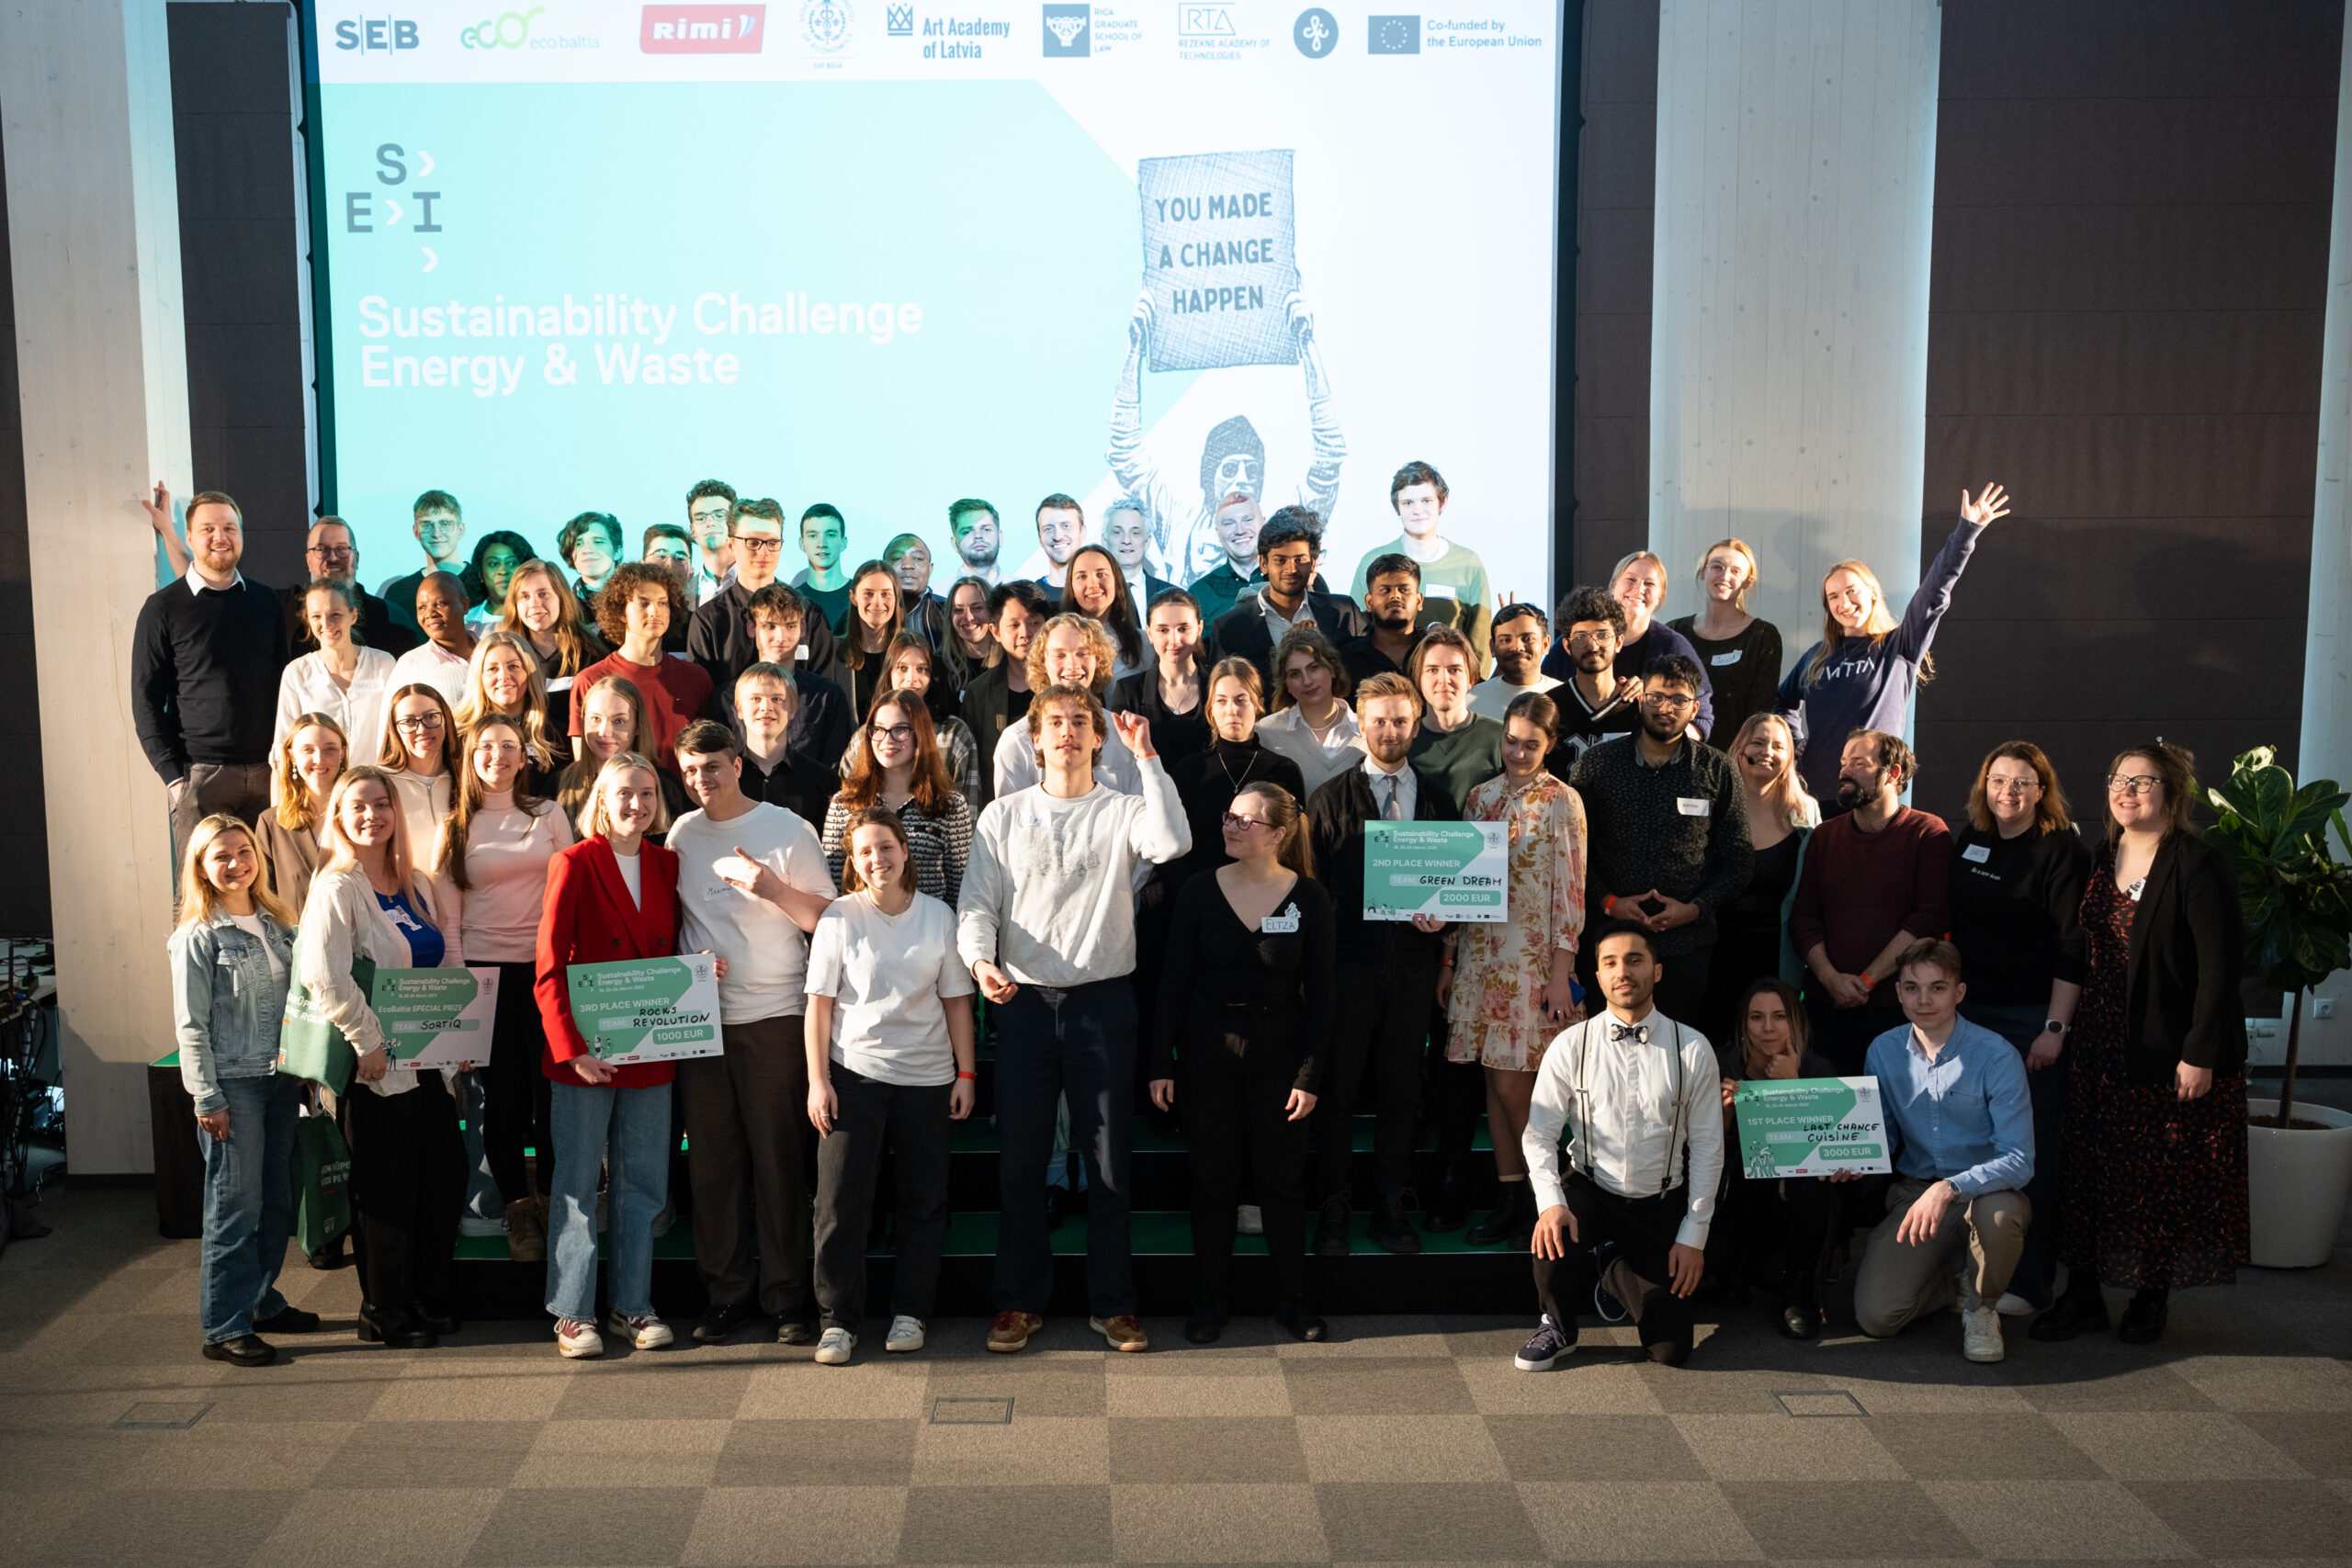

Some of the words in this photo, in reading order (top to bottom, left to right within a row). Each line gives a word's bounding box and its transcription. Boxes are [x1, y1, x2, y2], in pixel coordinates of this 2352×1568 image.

[922, 17, 944, 36] Art
[947, 17, 1011, 39] Academy
[1094, 20, 1139, 28] GRADUATE
[1427, 19, 1487, 30] Co-funded
[1491, 19, 1505, 33] by
[335, 20, 420, 50] SEB
[1094, 32, 1129, 40] SCHOOL
[1131, 32, 1142, 40] OF
[529, 37, 558, 50] eco
[560, 34, 600, 50] baltia
[1218, 39, 1257, 48] ACADEMY
[1260, 39, 1270, 48] OF
[1427, 36, 1445, 47] the
[1449, 36, 1505, 50] European
[1508, 36, 1543, 47] Union
[923, 40, 936, 59] of
[941, 40, 982, 59] Latvia
[1094, 45, 1112, 53] LAW
[1179, 51, 1241, 60] TECHNOLOGIES
[1155, 197, 1201, 222] YOU
[1208, 192, 1272, 220] MADE
[1159, 244, 1173, 269] A
[1181, 238, 1274, 267] CHANGE
[1173, 285, 1263, 314] HAPPEN
[358, 293, 676, 345] Sustainability
[693, 291, 923, 345] Challenge
[362, 344, 525, 399] Energy
[543, 343, 577, 386] &
[594, 342, 741, 385] Waste
[1393, 830, 1439, 839] Sustainability
[1441, 830, 1475, 839] Challenge
[1373, 859, 1391, 867] 2ND
[1393, 859, 1423, 867] PLACE
[1425, 860, 1461, 868] WINNER
[1419, 875, 1456, 886] GREEN
[1463, 875, 1502, 886] DREAM
[1443, 894, 1469, 902] 2000
[1471, 894, 1491, 902] EUR
[597, 970, 645, 979] Sustainability
[646, 966, 682, 976] Challenge
[399, 977, 440, 986] Sustainability
[441, 977, 470, 986] Challenge
[597, 977, 623, 987] Energy
[399, 985, 421, 993] Energy
[379, 1005, 411, 1013] EcoBaltia
[580, 1004, 598, 1012] 3RD
[600, 1000, 630, 1010] PLACE
[632, 997, 670, 1008] WINNER
[639, 1006, 677, 1017] ROCKS
[633, 1012, 710, 1028] REVOLUTION
[656, 1031, 683, 1041] 1000
[684, 1029, 704, 1039] EUR
[1762, 1088, 1810, 1096] Sustainability
[1810, 1087, 1844, 1096] Challenge
[1763, 1094, 1789, 1103] Energy
[1747, 1117, 1764, 1126] 1ST
[1766, 1116, 1795, 1125] PLACE
[1797, 1115, 1834, 1124] WINNER
[1804, 1123, 1831, 1132] LAST
[1838, 1122, 1881, 1132] CHANCE
[1823, 1148, 1849, 1157] 3000
[1851, 1147, 1871, 1156] EUR
